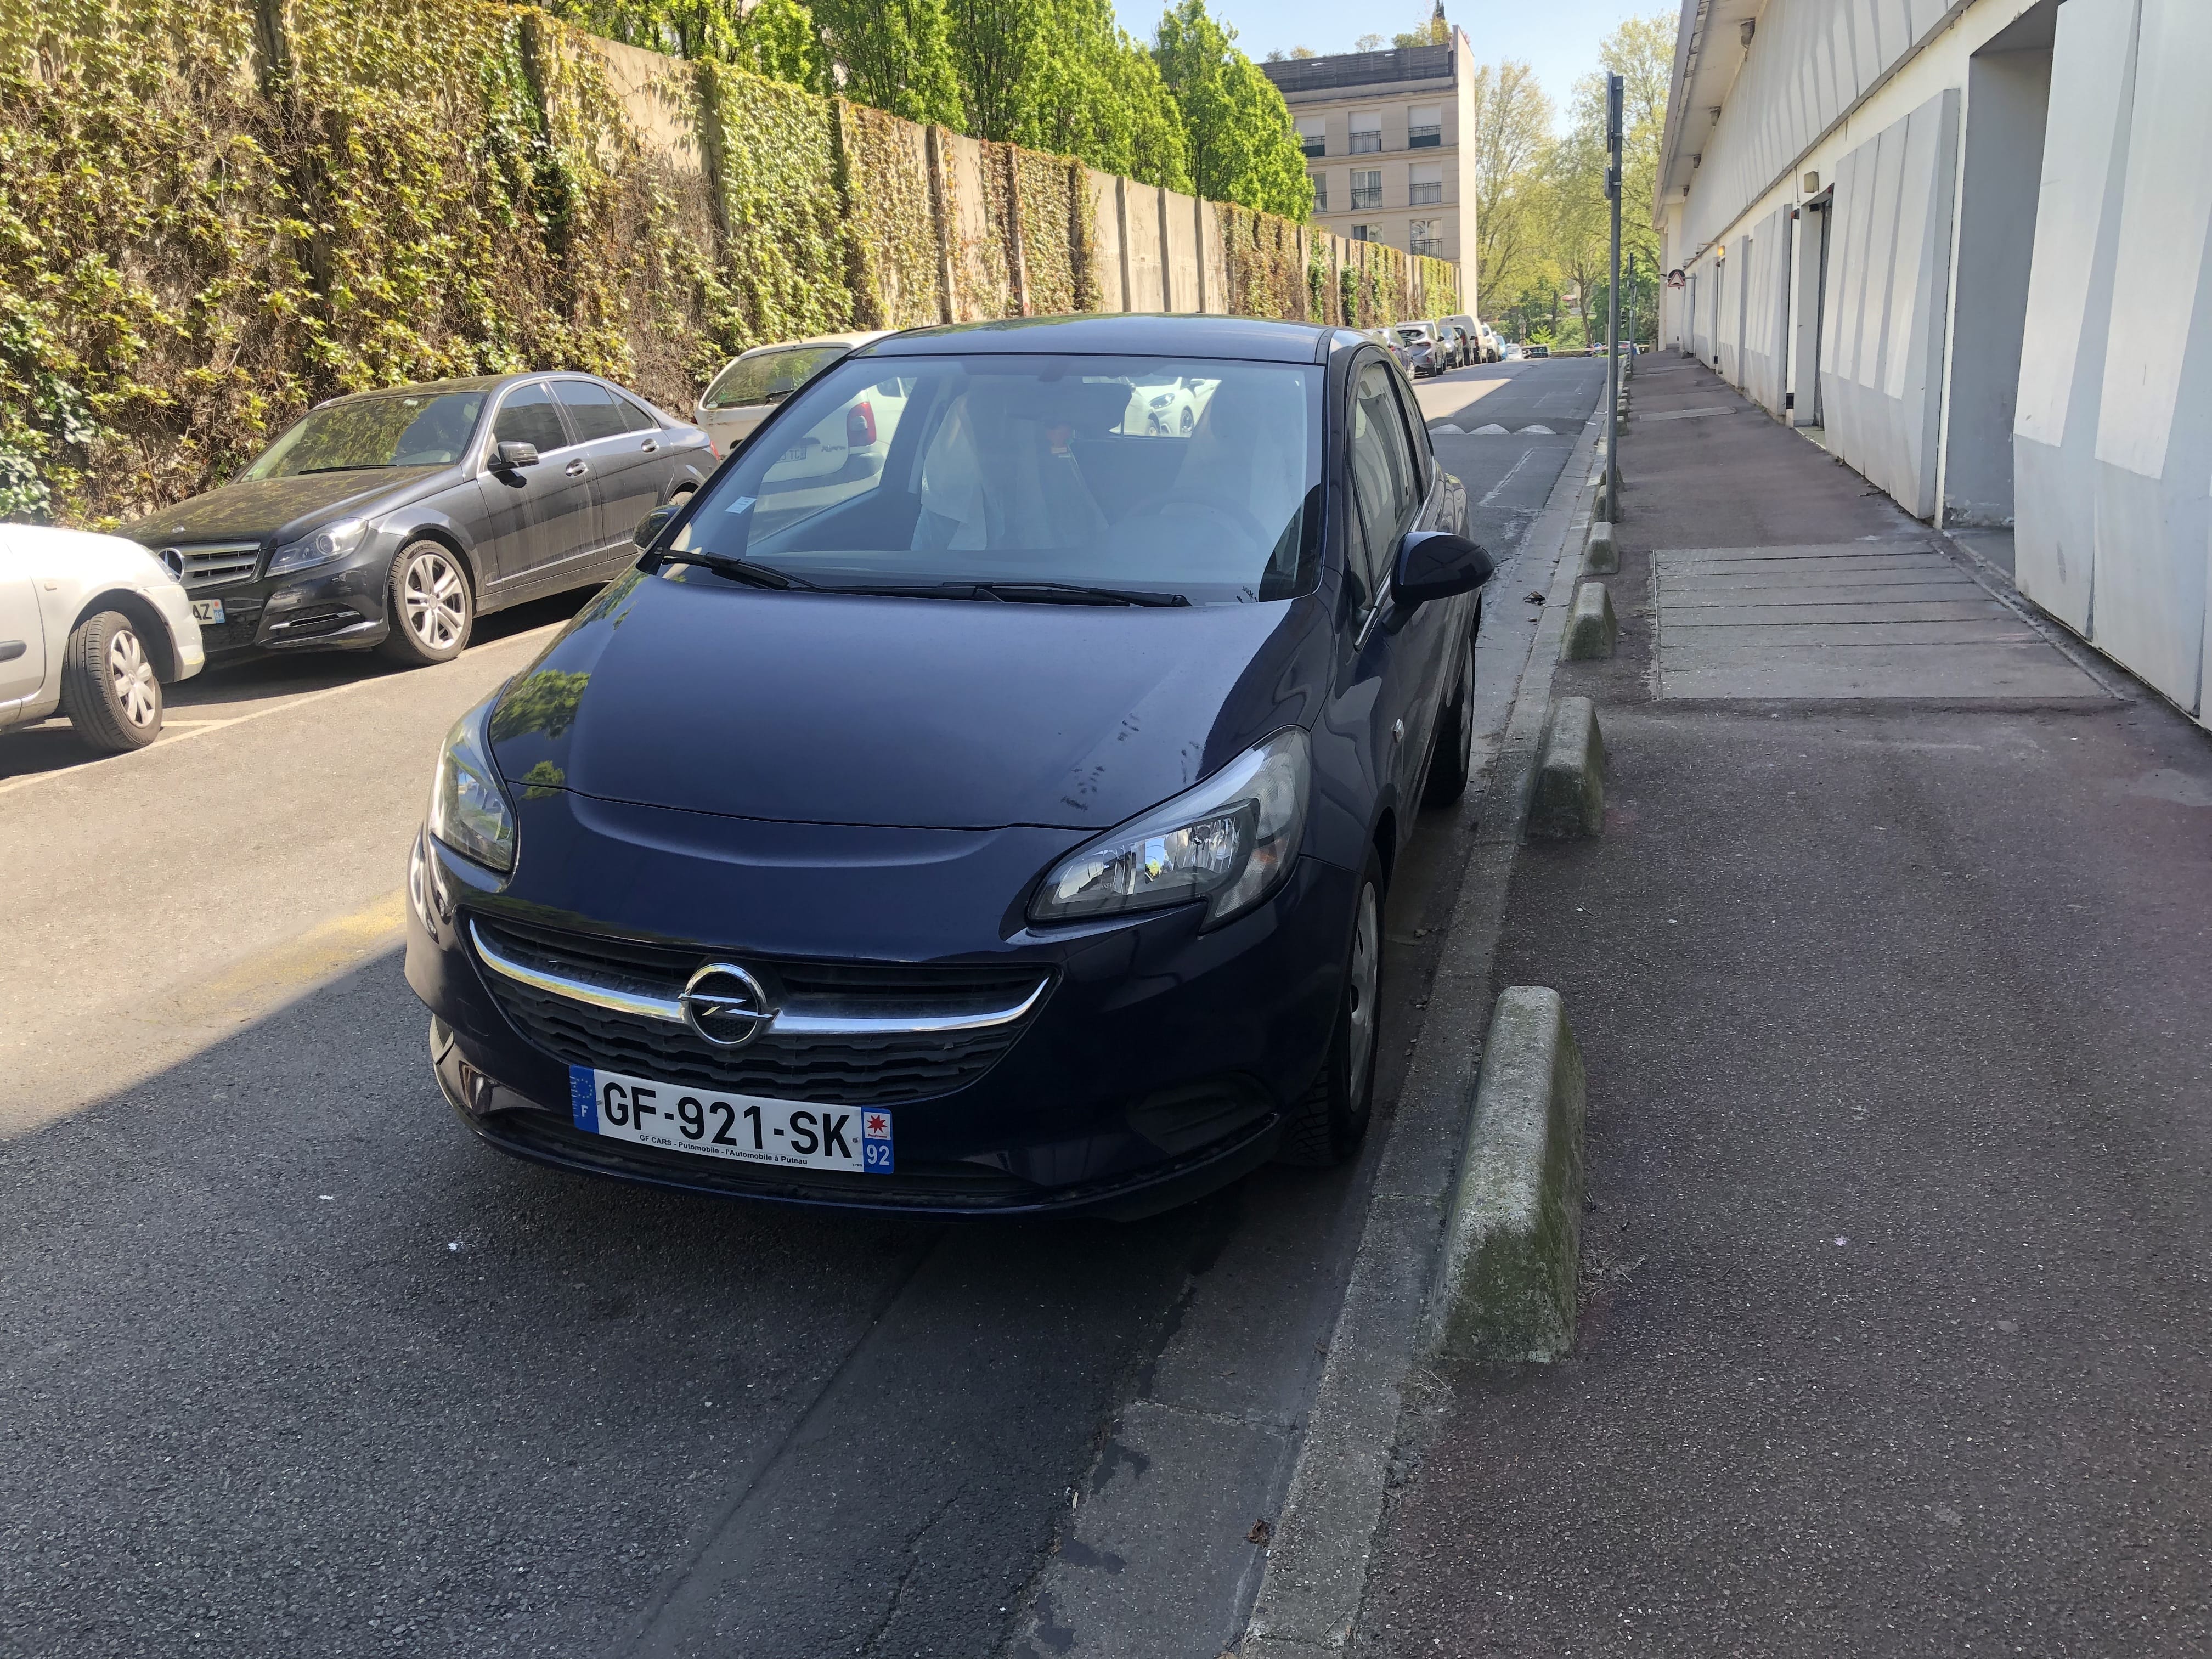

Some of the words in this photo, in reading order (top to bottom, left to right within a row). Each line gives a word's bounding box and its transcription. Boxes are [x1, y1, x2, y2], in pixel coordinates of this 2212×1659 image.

[215, 612, 224, 620] 92
[581, 1105, 588, 1117] F
[604, 1082, 853, 1158] GF-921-SK
[651, 1137, 672, 1146] CARS
[678, 1142, 719, 1154] Putomobile
[726, 1149, 772, 1161] l'Automobile
[781, 1156, 808, 1165] Puteau
[867, 1144, 890, 1166] 92
